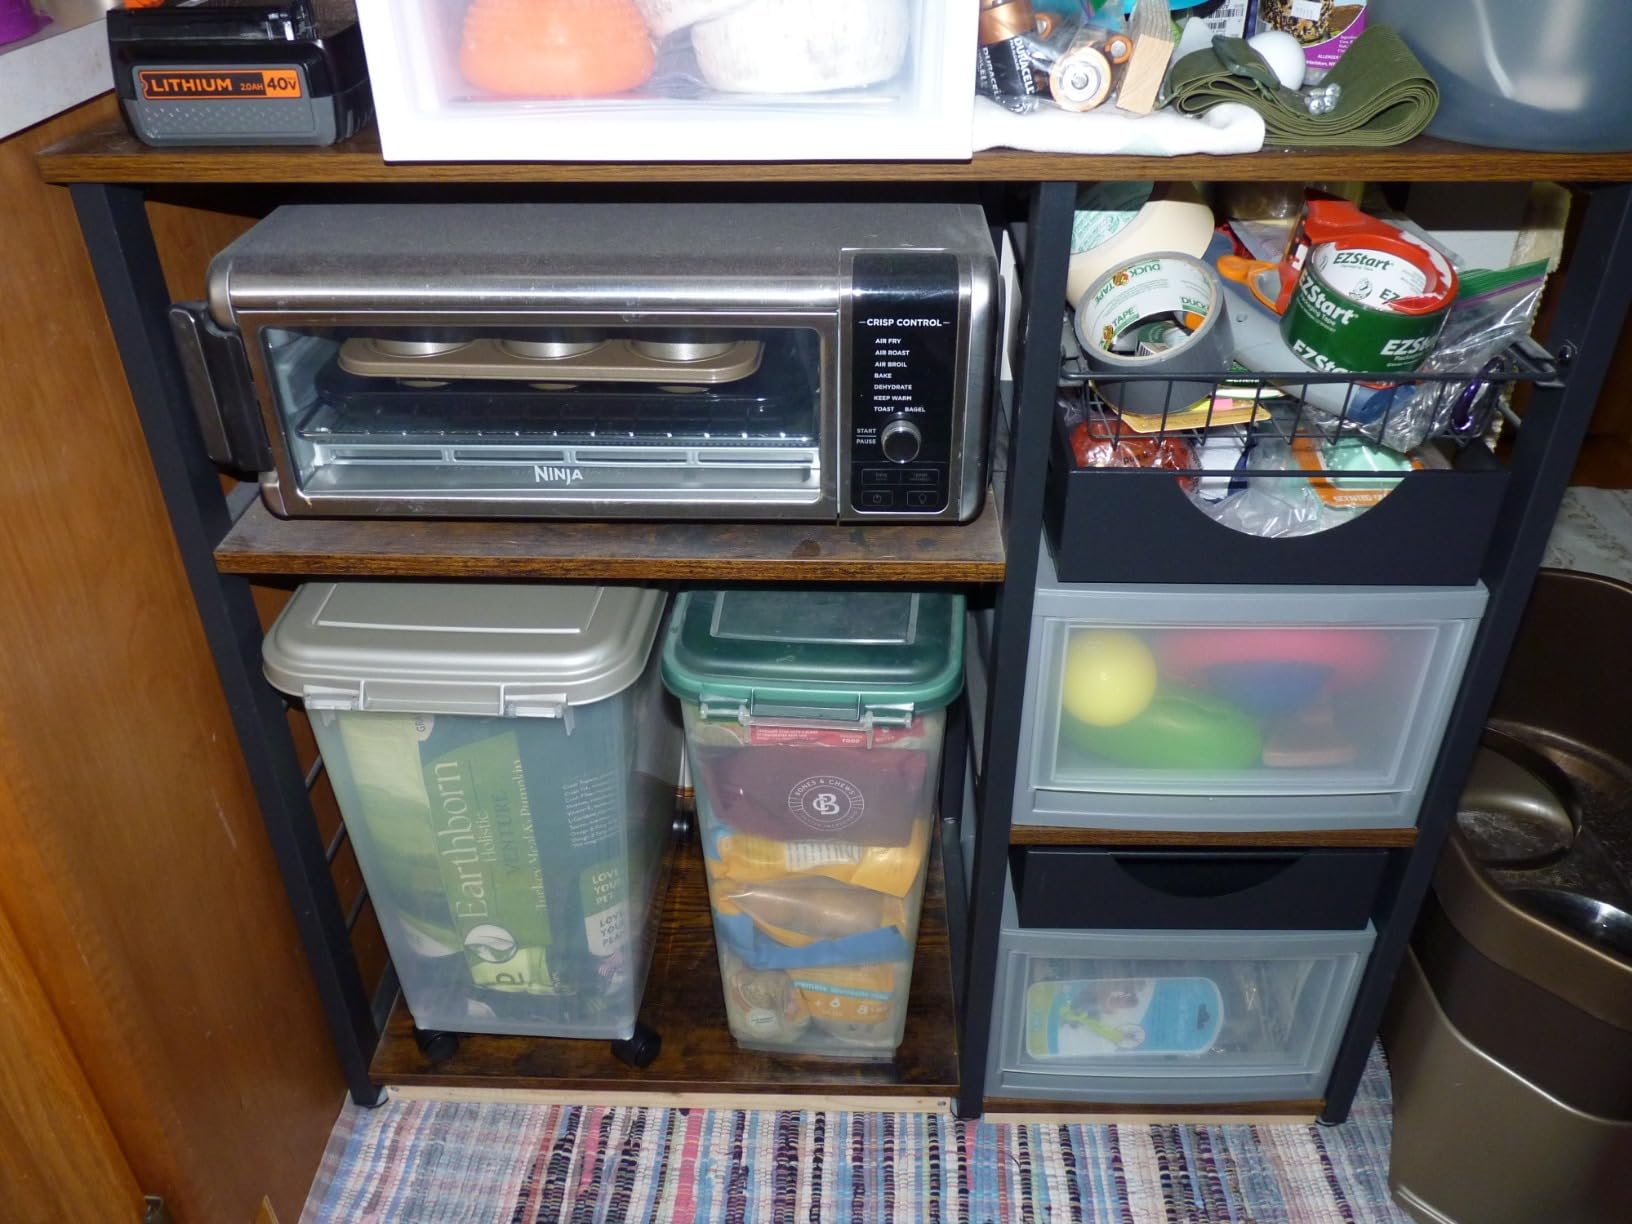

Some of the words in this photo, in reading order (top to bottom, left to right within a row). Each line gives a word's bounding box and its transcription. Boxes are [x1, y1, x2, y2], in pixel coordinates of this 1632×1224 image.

[151, 78, 233, 92] LITHIUM
[1129, 262, 1161, 278] DUCK
[1332, 252, 1391, 271] EZStart
[1094, 282, 1116, 305] TAPE
[866, 319, 895, 327] CRISP
[896, 319, 943, 327] CONTROL
[1112, 306, 1135, 327] TAPE
[534, 465, 584, 486] NINJA
[433, 760, 489, 918] Earthborn
[475, 809, 497, 862] Holistic
